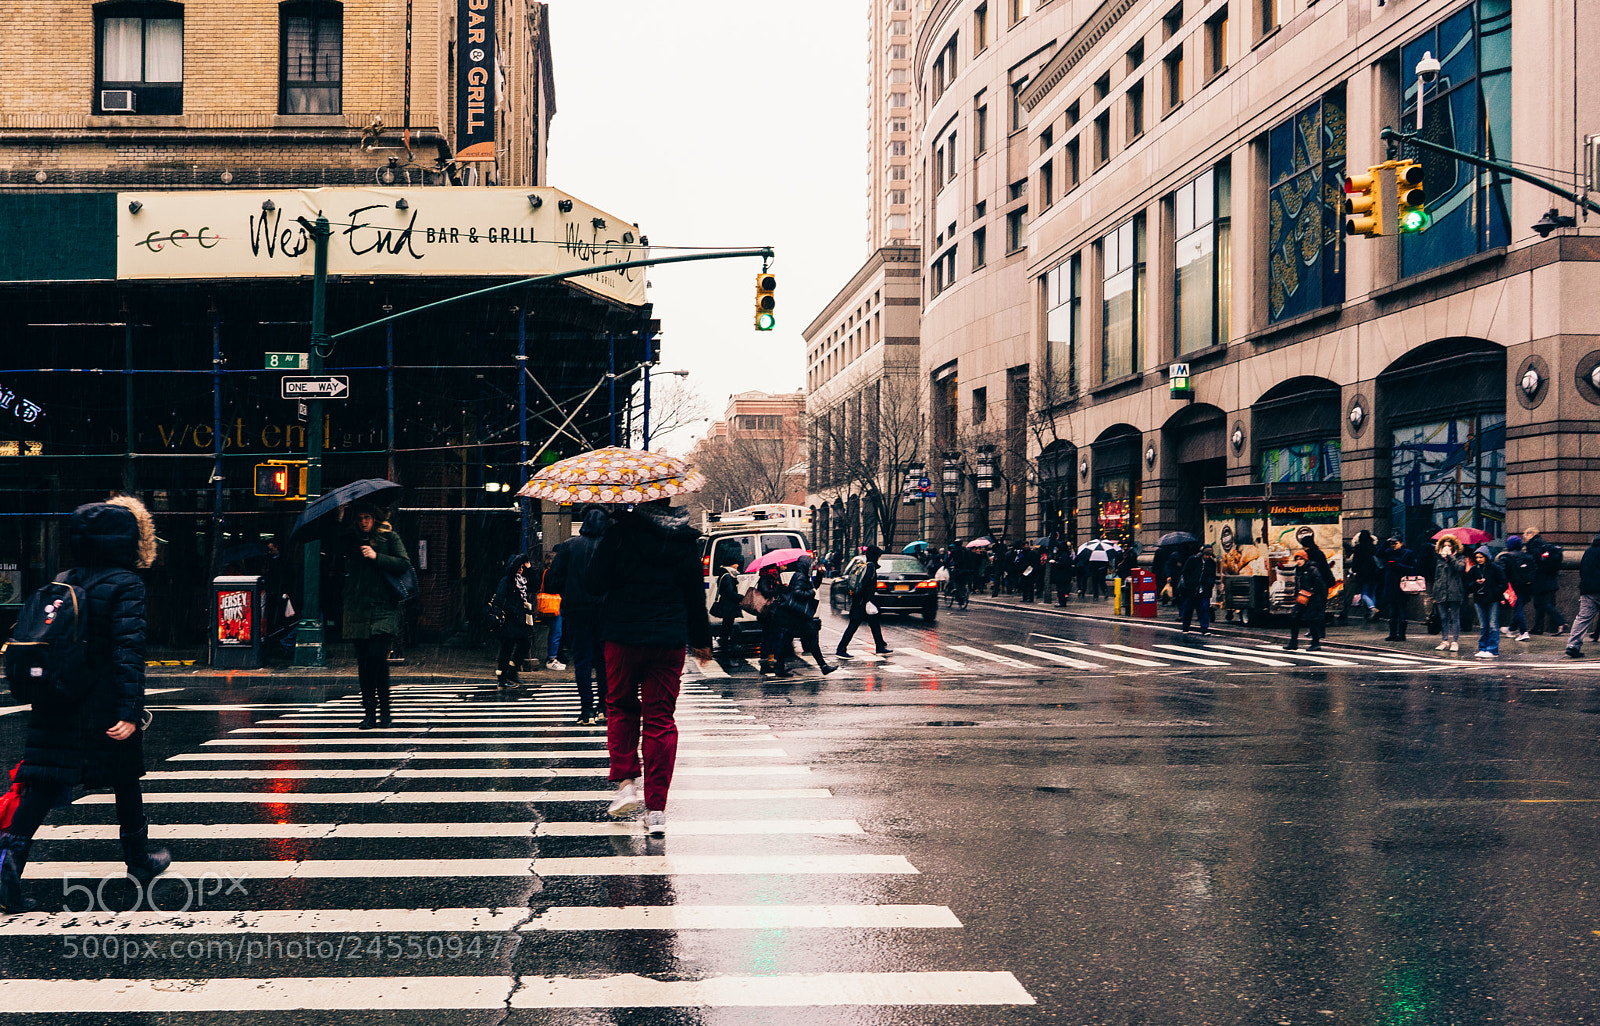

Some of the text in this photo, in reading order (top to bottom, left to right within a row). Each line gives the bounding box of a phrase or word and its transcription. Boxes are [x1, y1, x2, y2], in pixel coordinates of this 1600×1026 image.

[467, 67, 488, 134] GRILL
[250, 205, 539, 259] Wes End BAR & GRILL
[566, 222, 600, 264] West
[270, 354, 294, 367] 8 AV
[288, 383, 339, 392] ONE WAY
[275, 472, 286, 491] 4
[1270, 504, 1340, 514] Hot Sandwiches
[219, 592, 247, 609] JERSEY
[223, 607, 243, 620] BOYS
